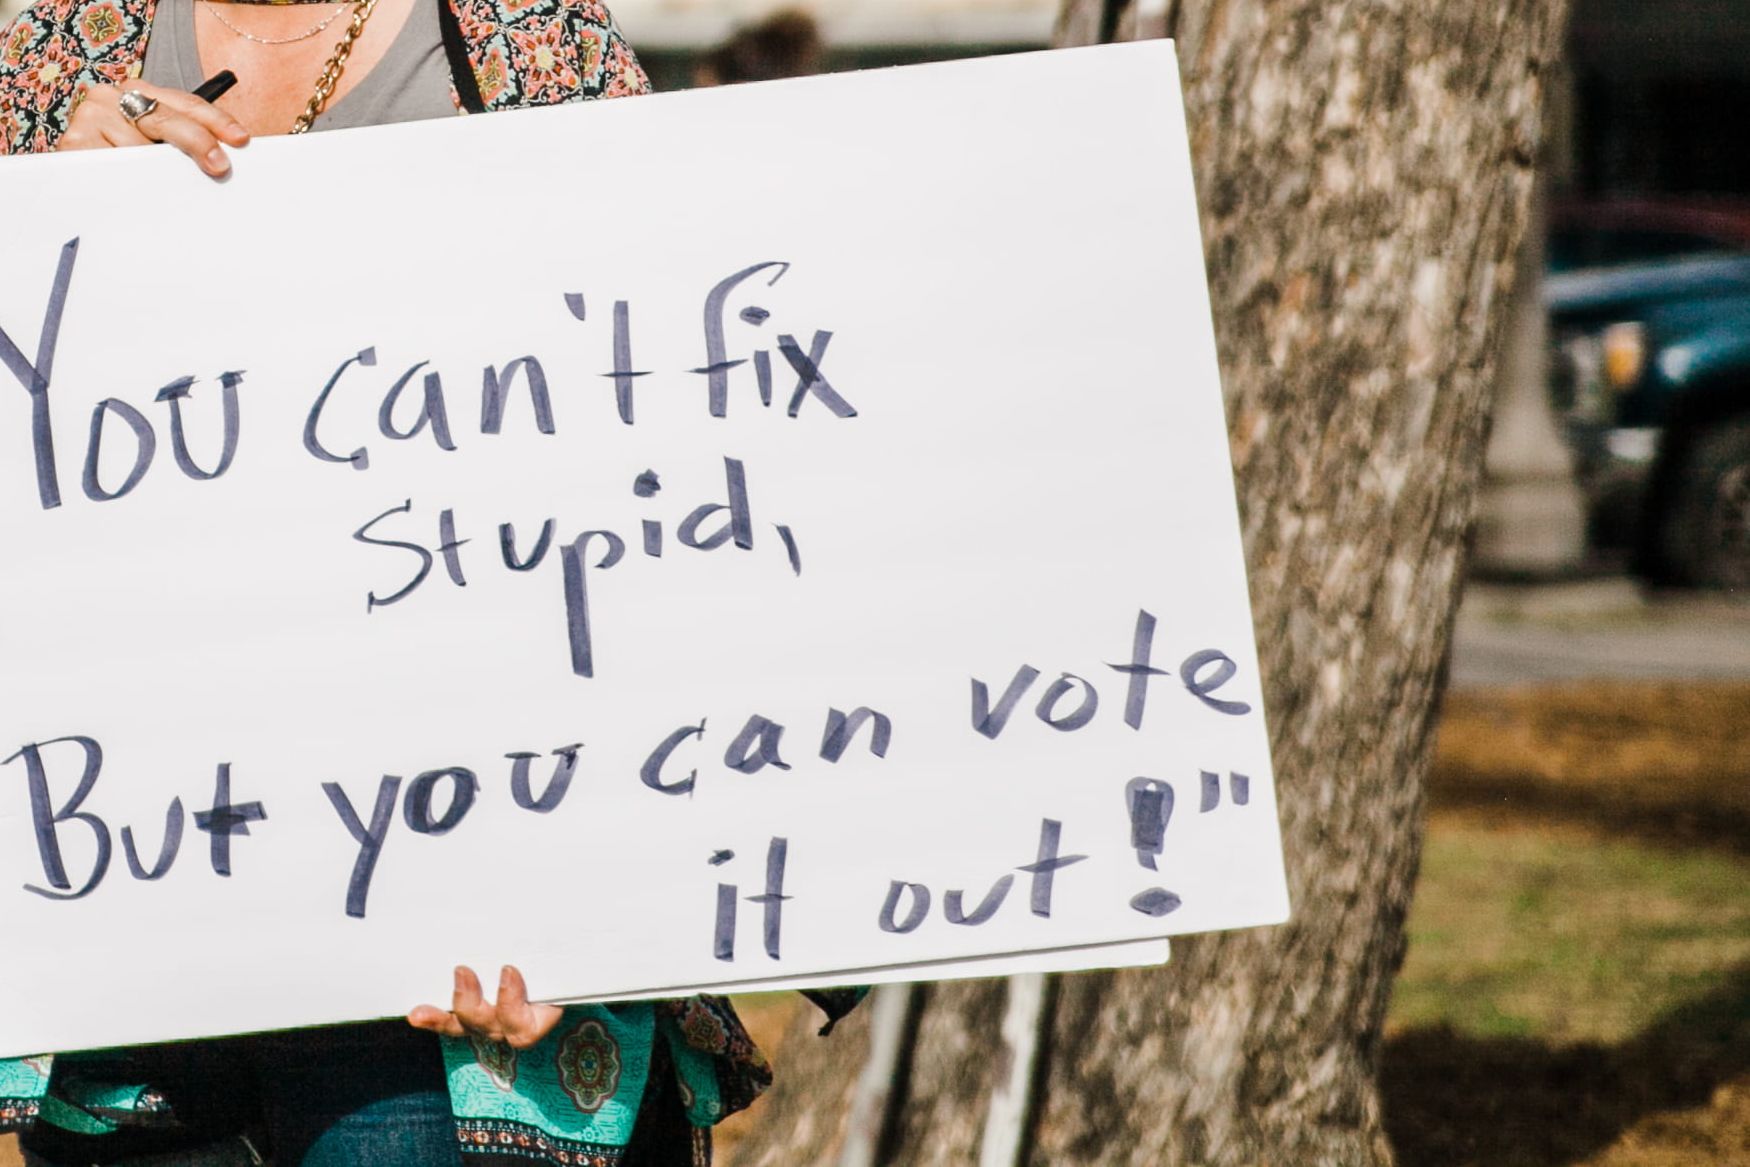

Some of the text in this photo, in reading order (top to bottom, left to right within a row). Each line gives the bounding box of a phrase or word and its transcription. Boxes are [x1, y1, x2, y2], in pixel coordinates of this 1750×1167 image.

[302, 291, 655, 472] can't
[684, 260, 860, 421] fix
[319, 741, 586, 921] you
[638, 705, 893, 798] can
[968, 607, 1253, 742] vote
[705, 835, 796, 965] it
